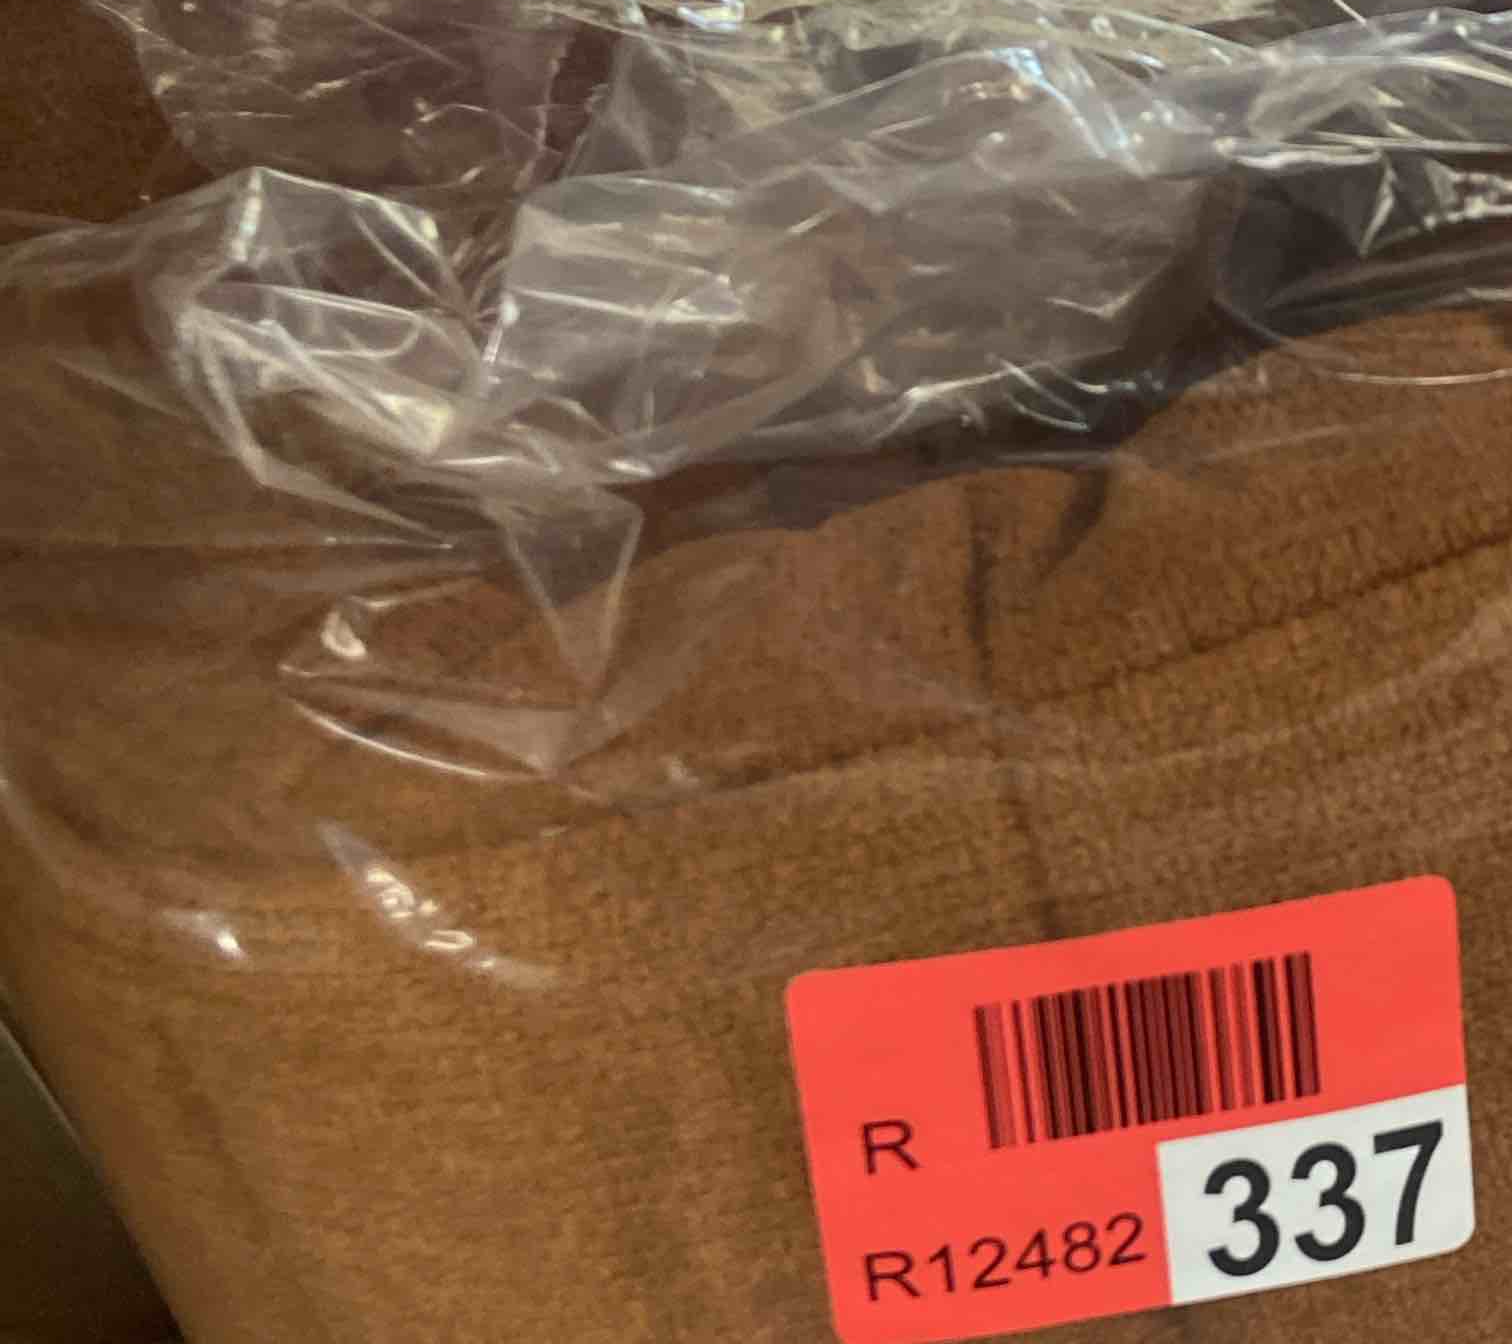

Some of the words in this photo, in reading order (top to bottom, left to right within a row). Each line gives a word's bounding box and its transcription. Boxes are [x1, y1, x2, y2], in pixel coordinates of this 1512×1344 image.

[860, 1118, 921, 1176] R
[1202, 1119, 1445, 1278] 337
[863, 1210, 1148, 1302] R12482
